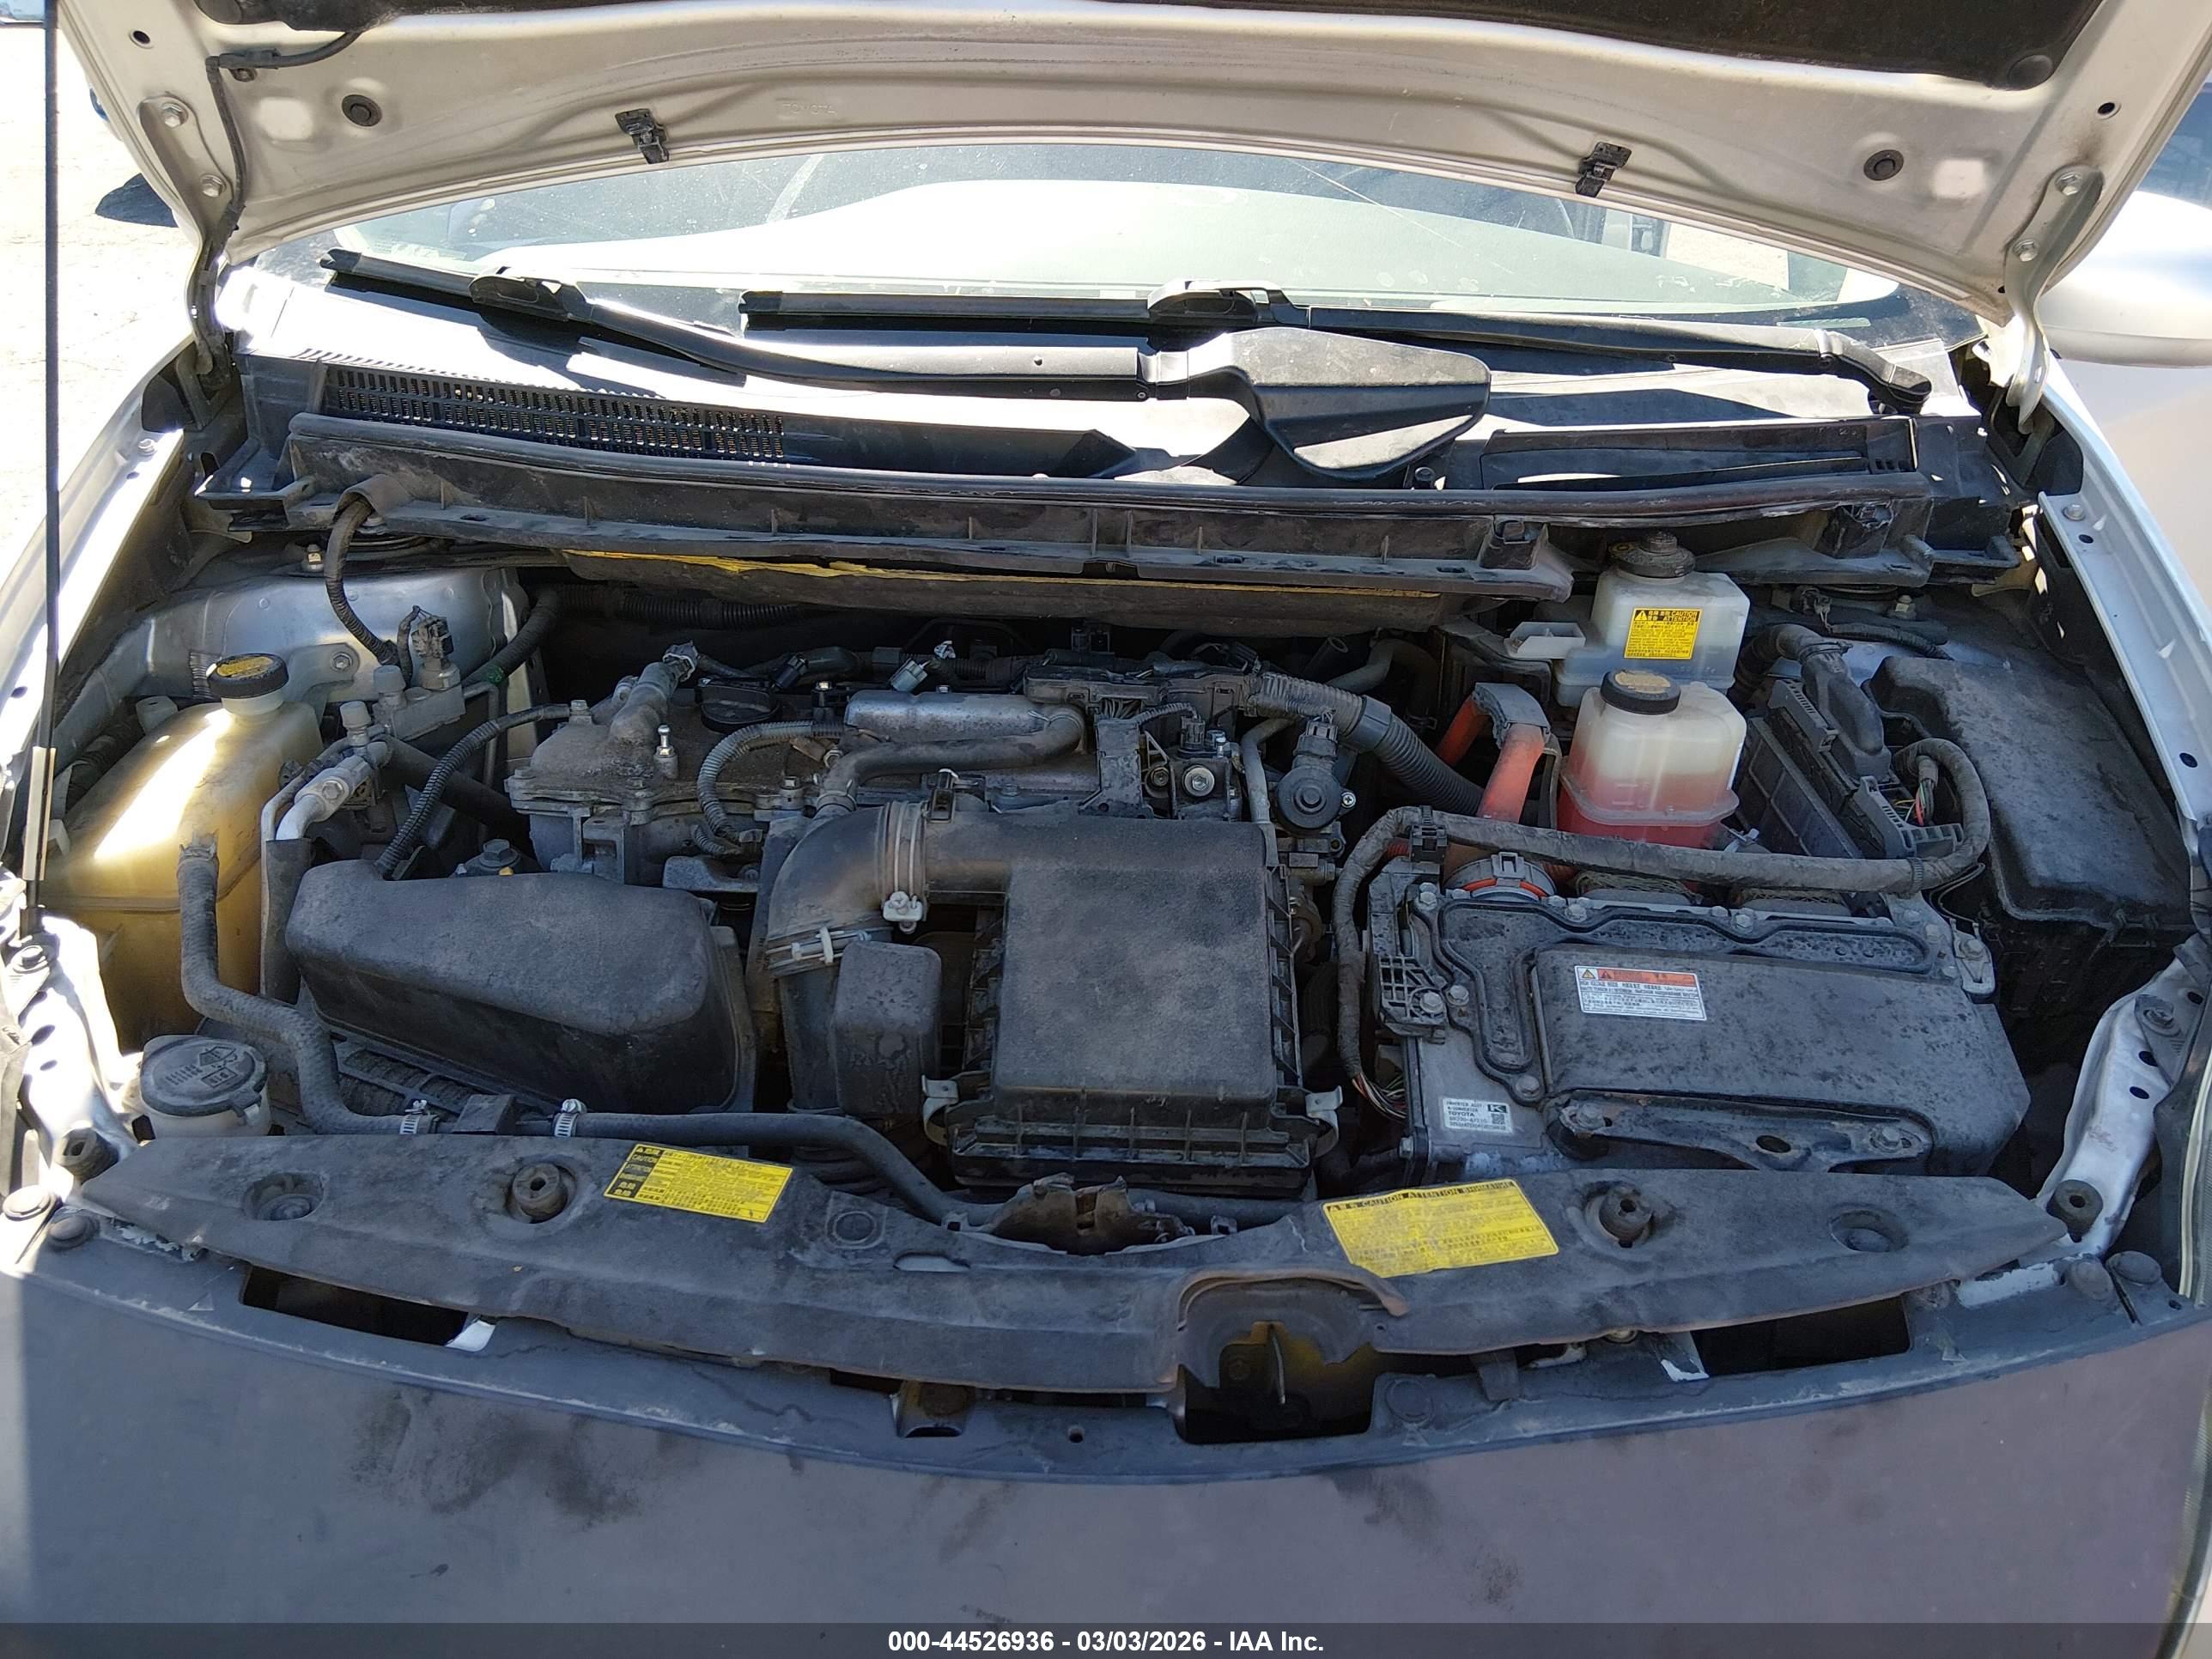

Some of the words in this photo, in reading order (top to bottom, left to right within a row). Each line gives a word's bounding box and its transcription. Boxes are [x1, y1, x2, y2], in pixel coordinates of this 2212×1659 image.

[782, 102, 838, 115] TOYOTA
[632, 1154, 658, 1164] CAUTION
[1363, 1194, 1403, 1207] CAUTION
[1408, 1188, 1459, 1200] ATTENTION
